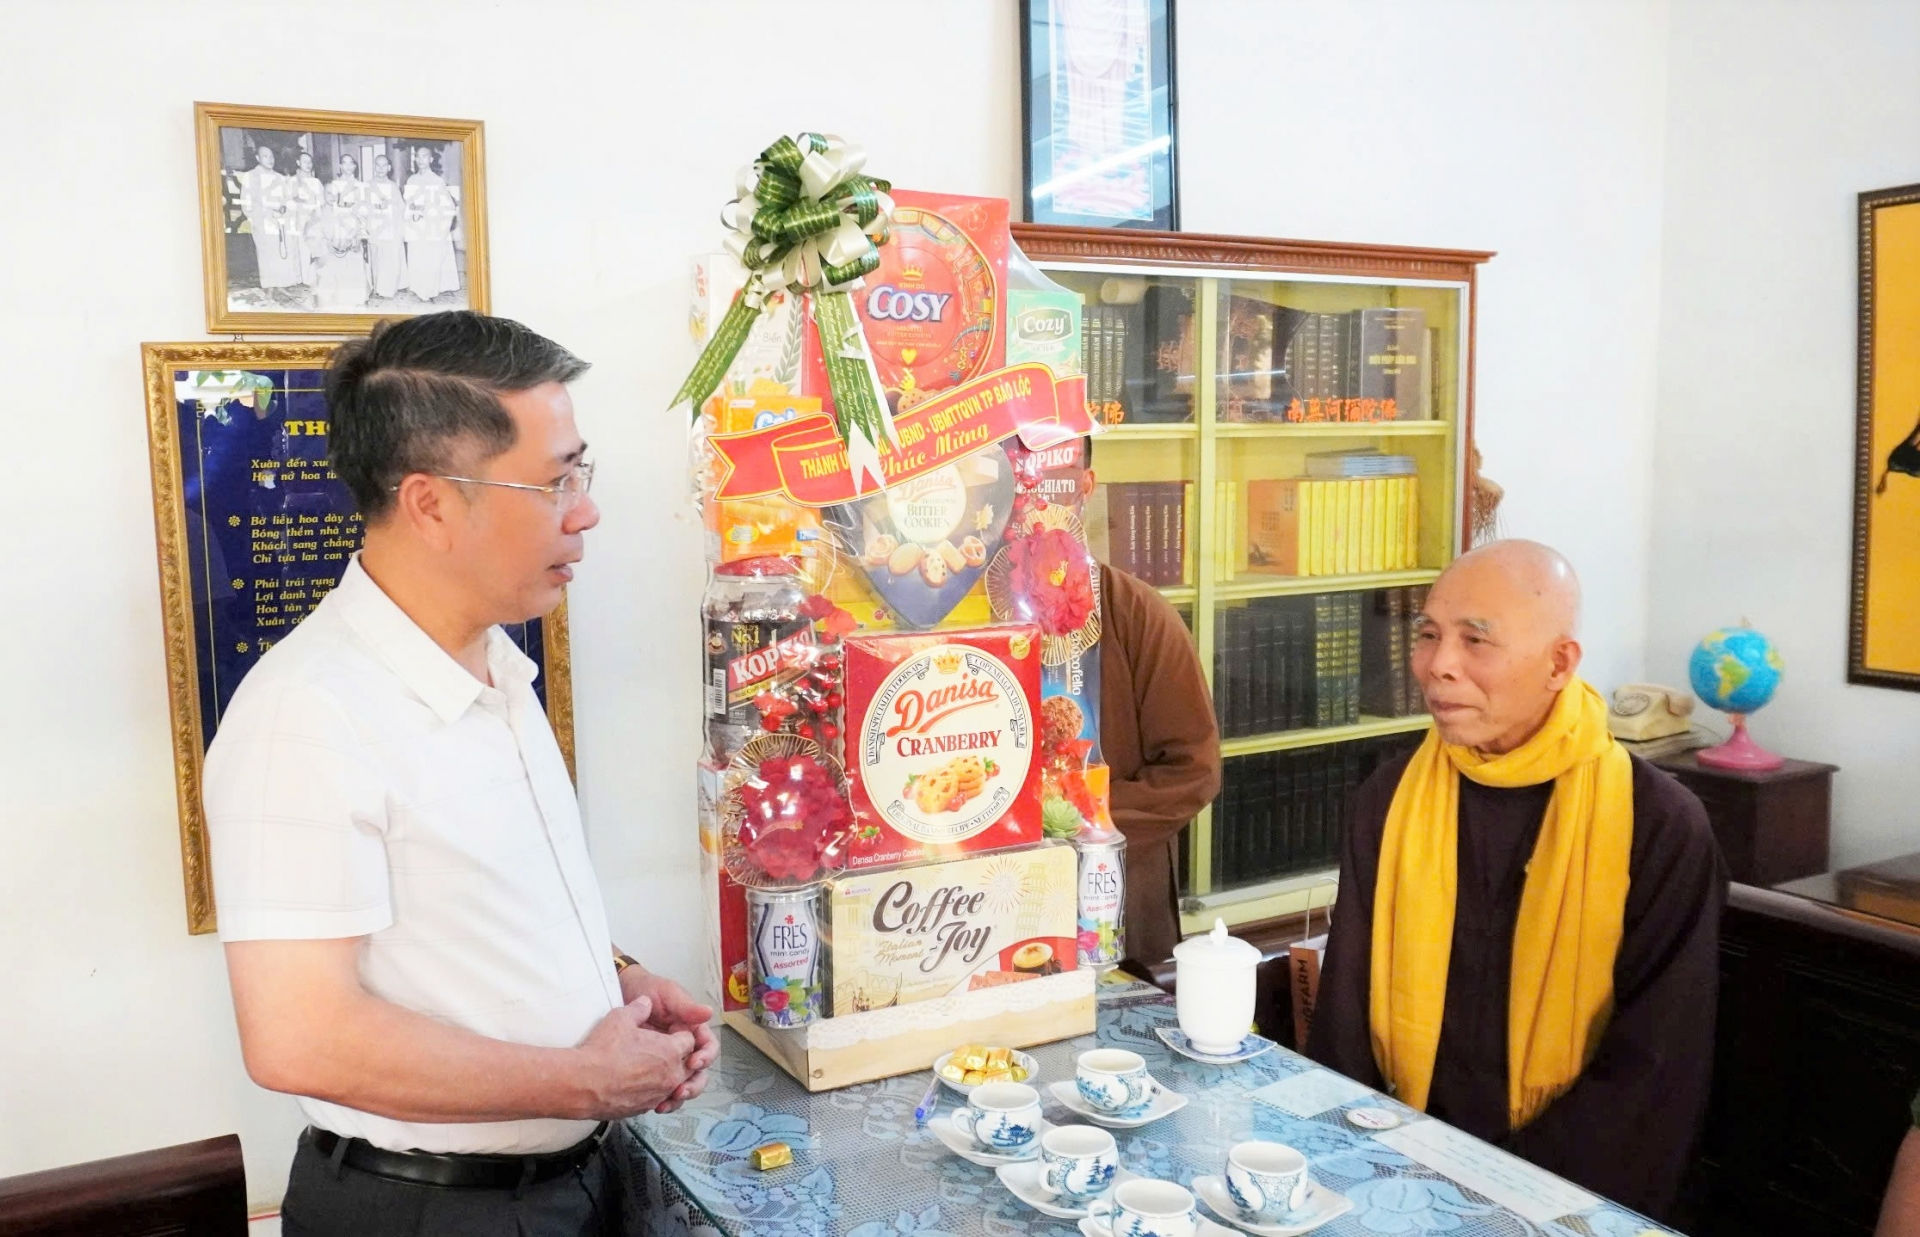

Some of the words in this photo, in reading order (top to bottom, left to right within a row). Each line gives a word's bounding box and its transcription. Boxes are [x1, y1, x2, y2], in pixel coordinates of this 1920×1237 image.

[867, 284, 952, 322] COSY
[1023, 316, 1065, 336] Cozy
[898, 421, 926, 447] UBND
[929, 398, 982, 435] UBMTTQVN
[980, 389, 994, 409] TP
[993, 377, 1014, 405] BẢO
[1012, 374, 1032, 401] LỘC
[284, 420, 330, 436] TH
[931, 422, 990, 461] Mừng
[251, 459, 280, 469] Xuân
[800, 452, 838, 479] THÀNH
[839, 443, 850, 470] Ủ
[252, 471, 275, 482] Hoa
[301, 470, 320, 480] hoa
[326, 469, 338, 479] th
[299, 514, 319, 524] hoa
[349, 512, 362, 522] ch
[907, 504, 946, 517] BUTTER
[904, 518, 950, 529] COOKIES
[251, 529, 280, 539] Bóng
[320, 526, 339, 536] nhà
[252, 541, 287, 551] Khách
[293, 541, 317, 550] sang
[302, 552, 318, 561] lan
[324, 553, 342, 561] can
[255, 592, 274, 603] Lợi
[280, 590, 306, 600] danh
[312, 588, 330, 598] lạn
[256, 605, 278, 614] Hoa
[284, 603, 302, 612] tàn
[256, 616, 285, 627] Xuân
[732, 630, 811, 684] KOPO
[886, 672, 1000, 738] Danisa
[897, 730, 1002, 758] CRANBERRY
[852, 855, 873, 866] Danisa
[873, 851, 901, 862] Cranberry
[1087, 870, 1117, 895] FRES
[873, 881, 985, 935] Coffee
[773, 922, 808, 950] FRES
[920, 920, 991, 973] Joy
[773, 957, 809, 970] Assorted
